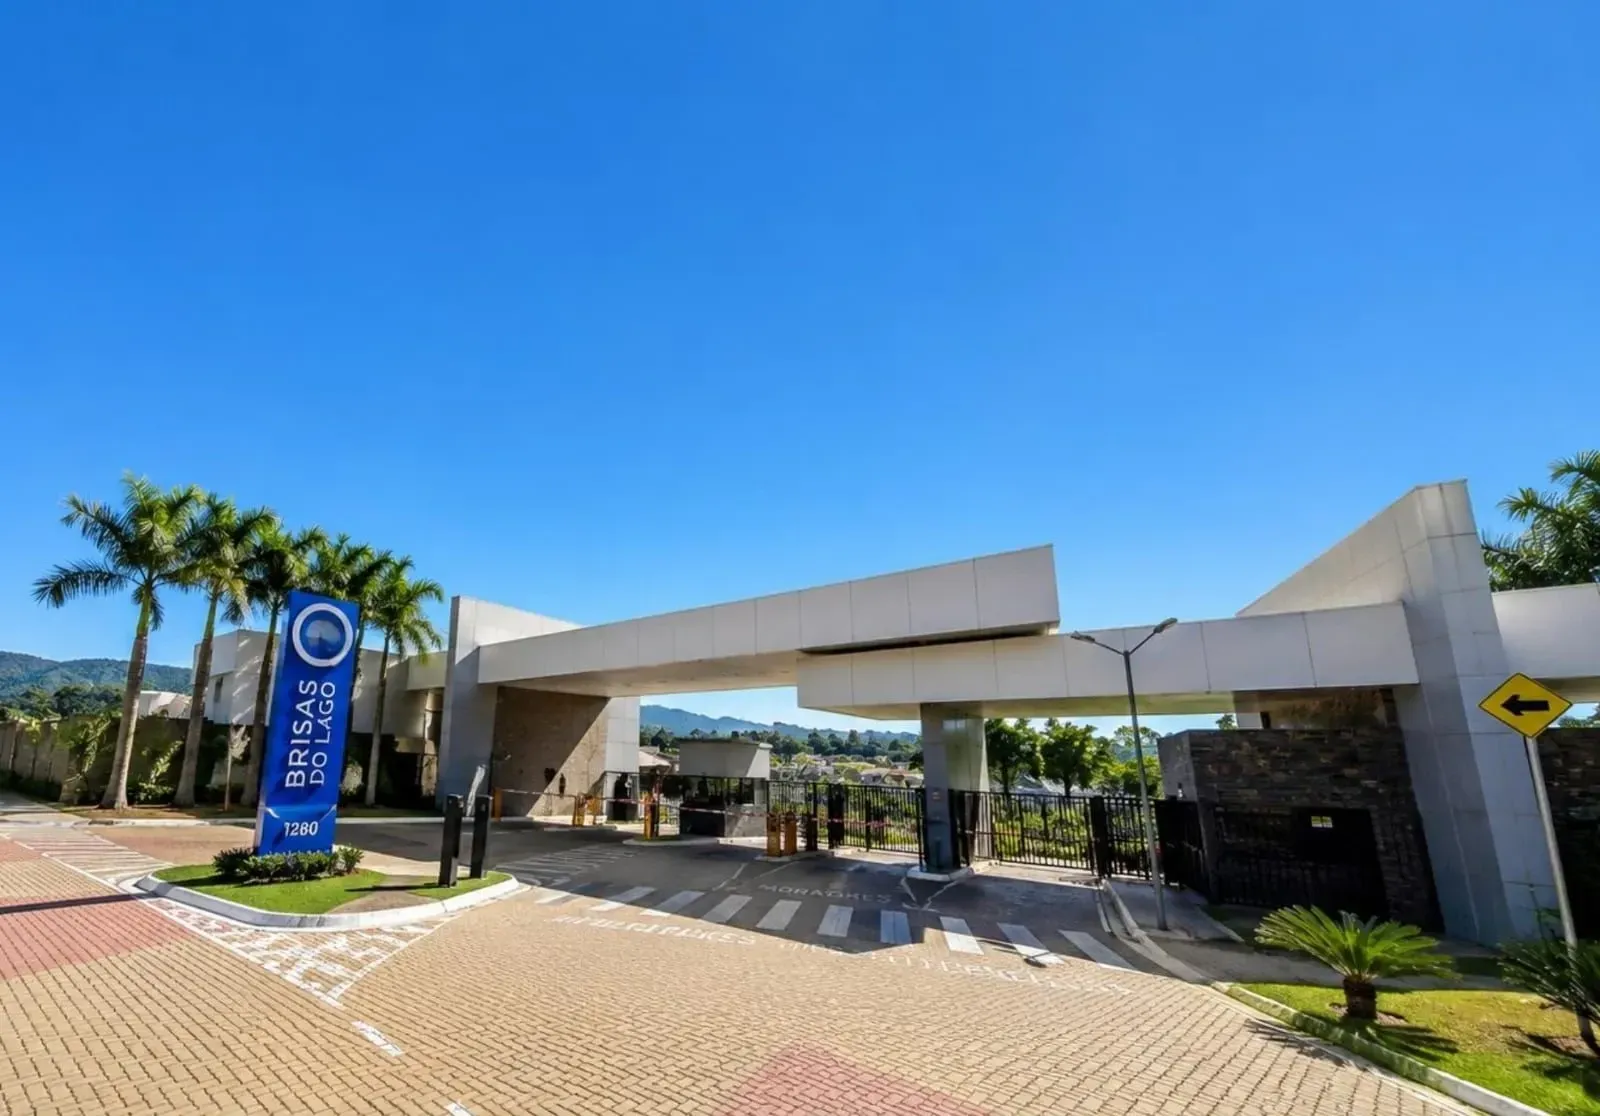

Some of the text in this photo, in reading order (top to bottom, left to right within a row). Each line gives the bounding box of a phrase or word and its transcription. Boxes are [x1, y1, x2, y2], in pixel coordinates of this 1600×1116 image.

[285, 680, 317, 788] BRISAS
[309, 681, 336, 785] DO LAGO
[283, 820, 319, 837] 1280
